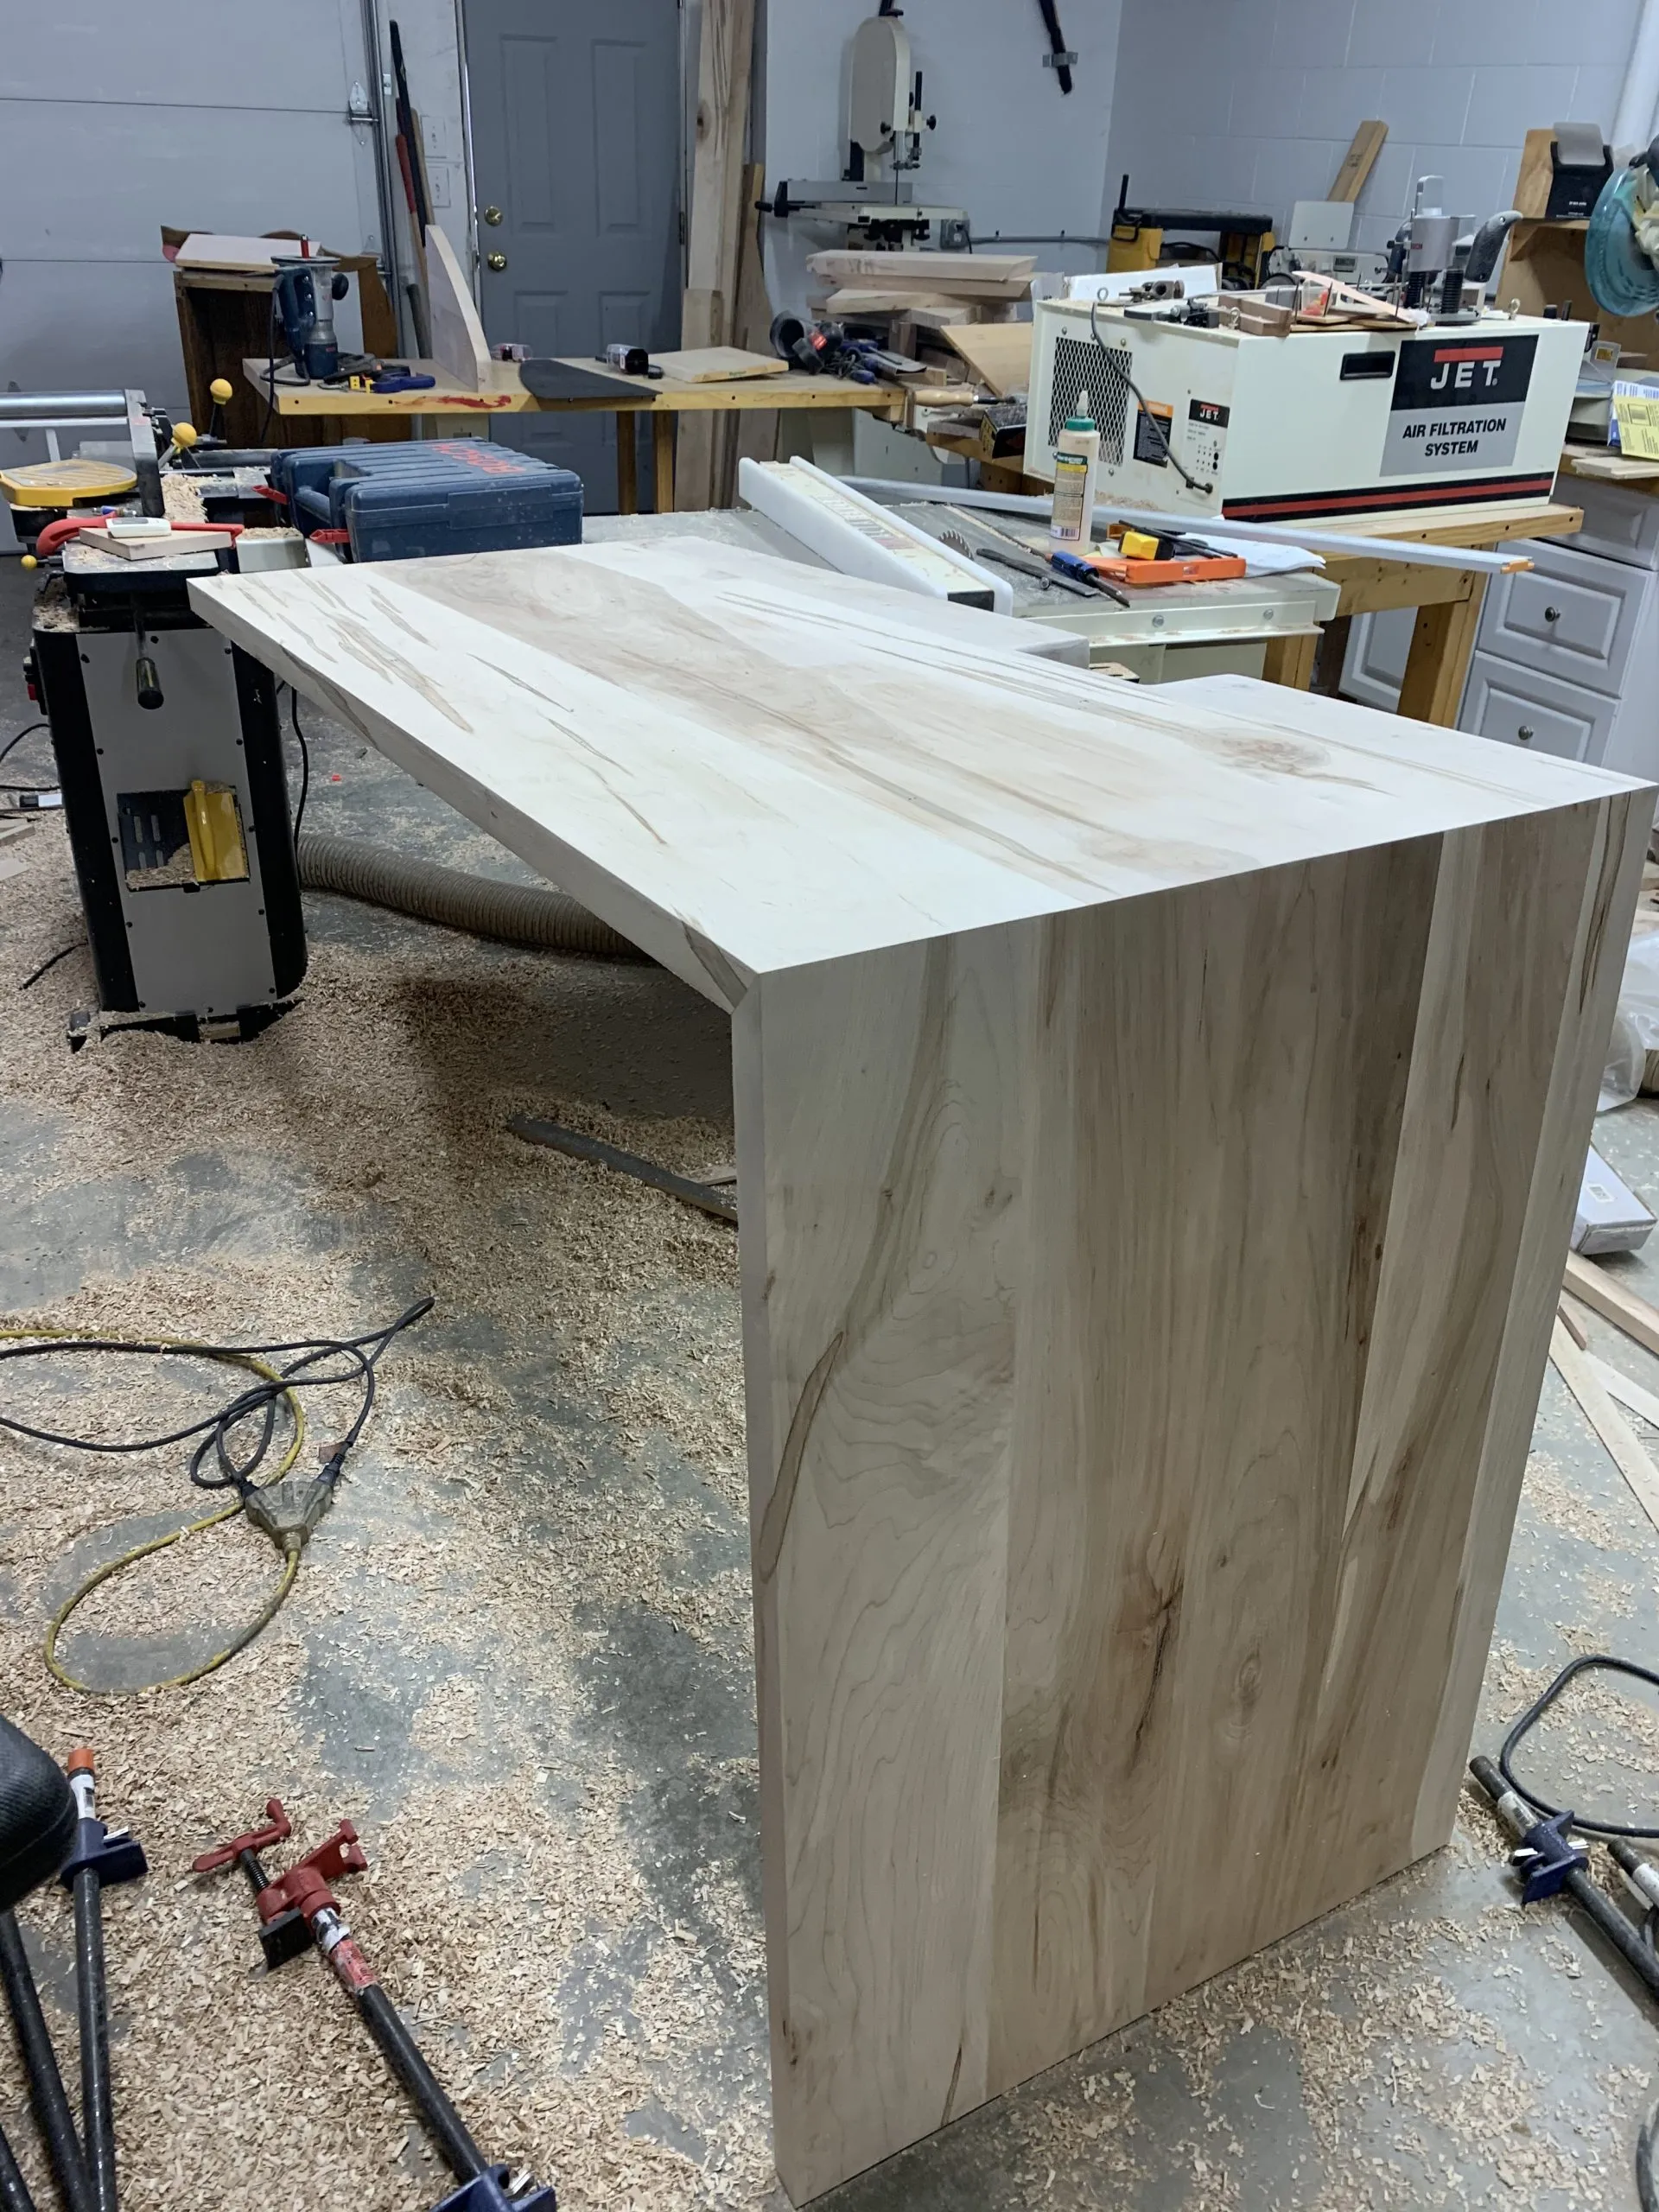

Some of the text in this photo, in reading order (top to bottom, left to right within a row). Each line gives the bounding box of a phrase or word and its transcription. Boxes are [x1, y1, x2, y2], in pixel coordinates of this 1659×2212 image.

[1430, 359, 1502, 390] JET
[1199, 409, 1219, 421] JET
[1402, 418, 1507, 439] AIR FILTRATION
[1424, 440, 1479, 457] SYSTEM
